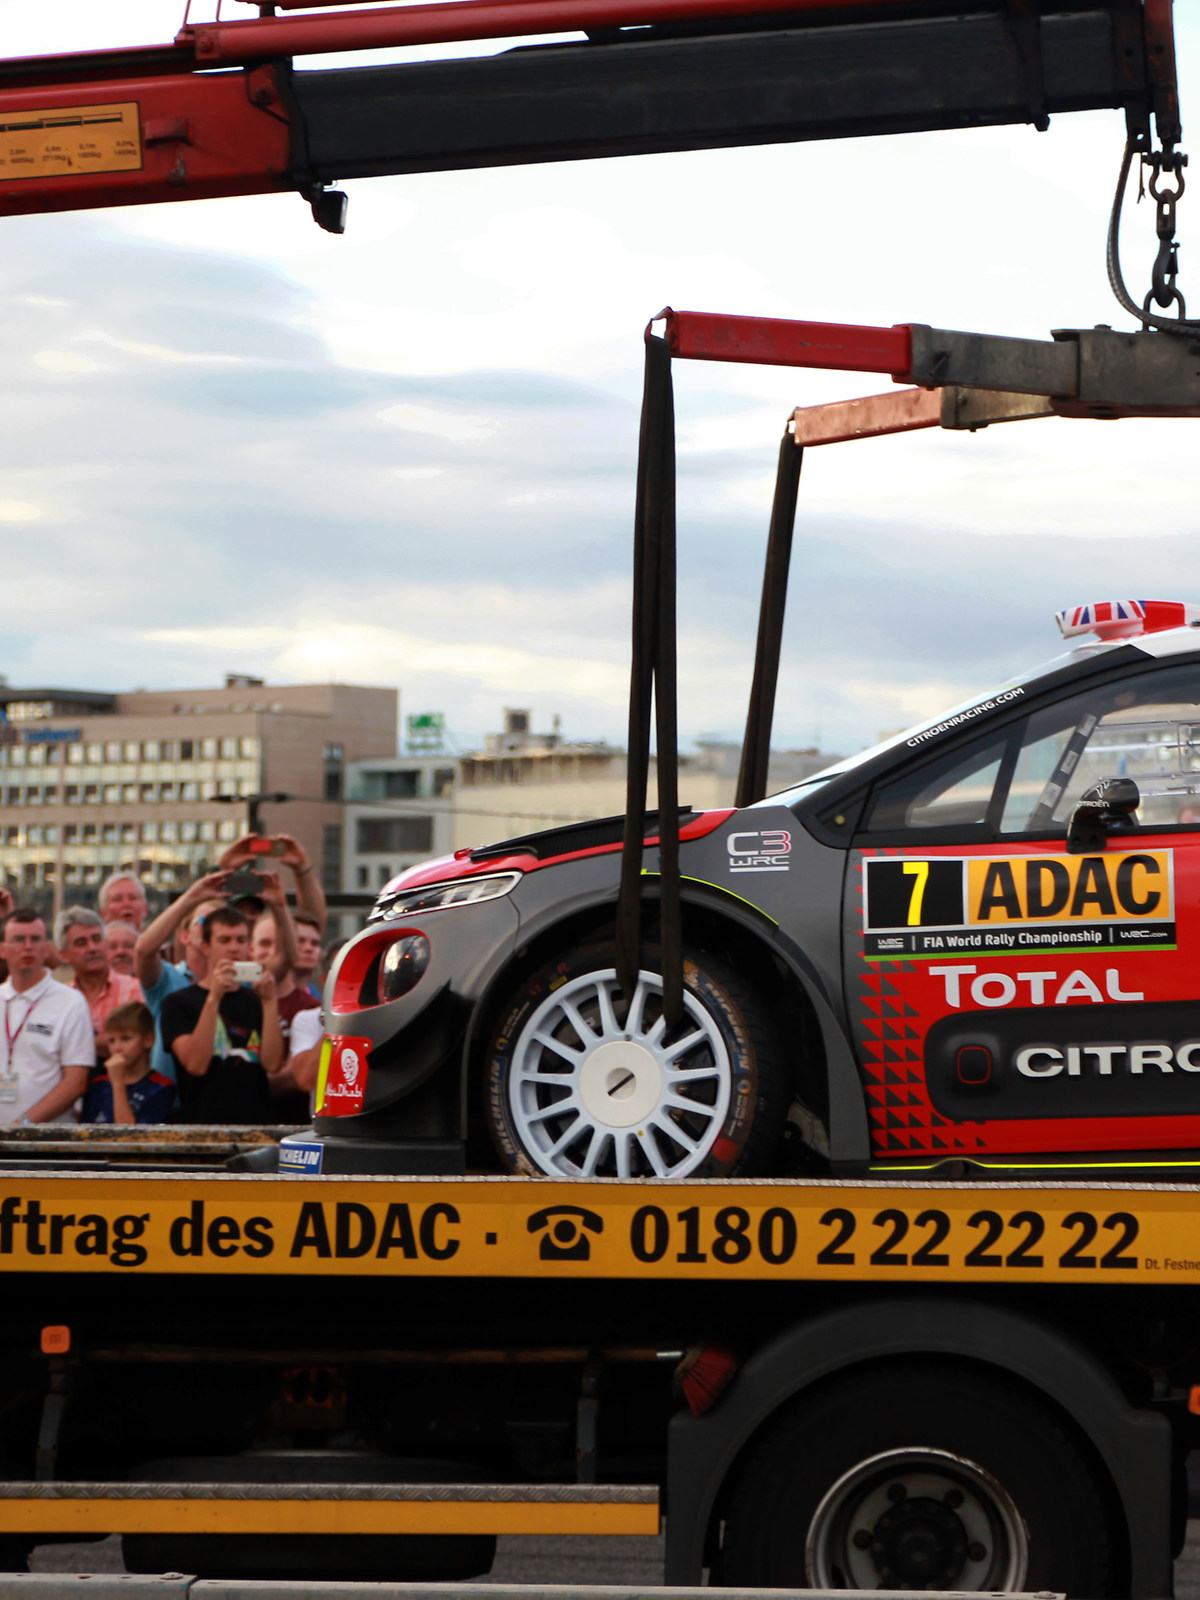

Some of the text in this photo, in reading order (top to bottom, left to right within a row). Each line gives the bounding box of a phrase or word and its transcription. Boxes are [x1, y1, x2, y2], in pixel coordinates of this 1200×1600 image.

[906, 687, 1025, 748] CITROENRACING.COM
[727, 830, 791, 856] C3
[729, 855, 790, 867] WRC
[902, 861, 930, 926] 7
[977, 855, 1161, 920] ADAC
[923, 936, 944, 949] FIA
[947, 935, 981, 947] World
[985, 934, 1015, 947] Rally
[1018, 930, 1102, 944] Championship
[0, 1197, 1139, 1269] ftrag des ADAC 0180 2 22 22 22
[1145, 1259, 1160, 1270] Dt.
